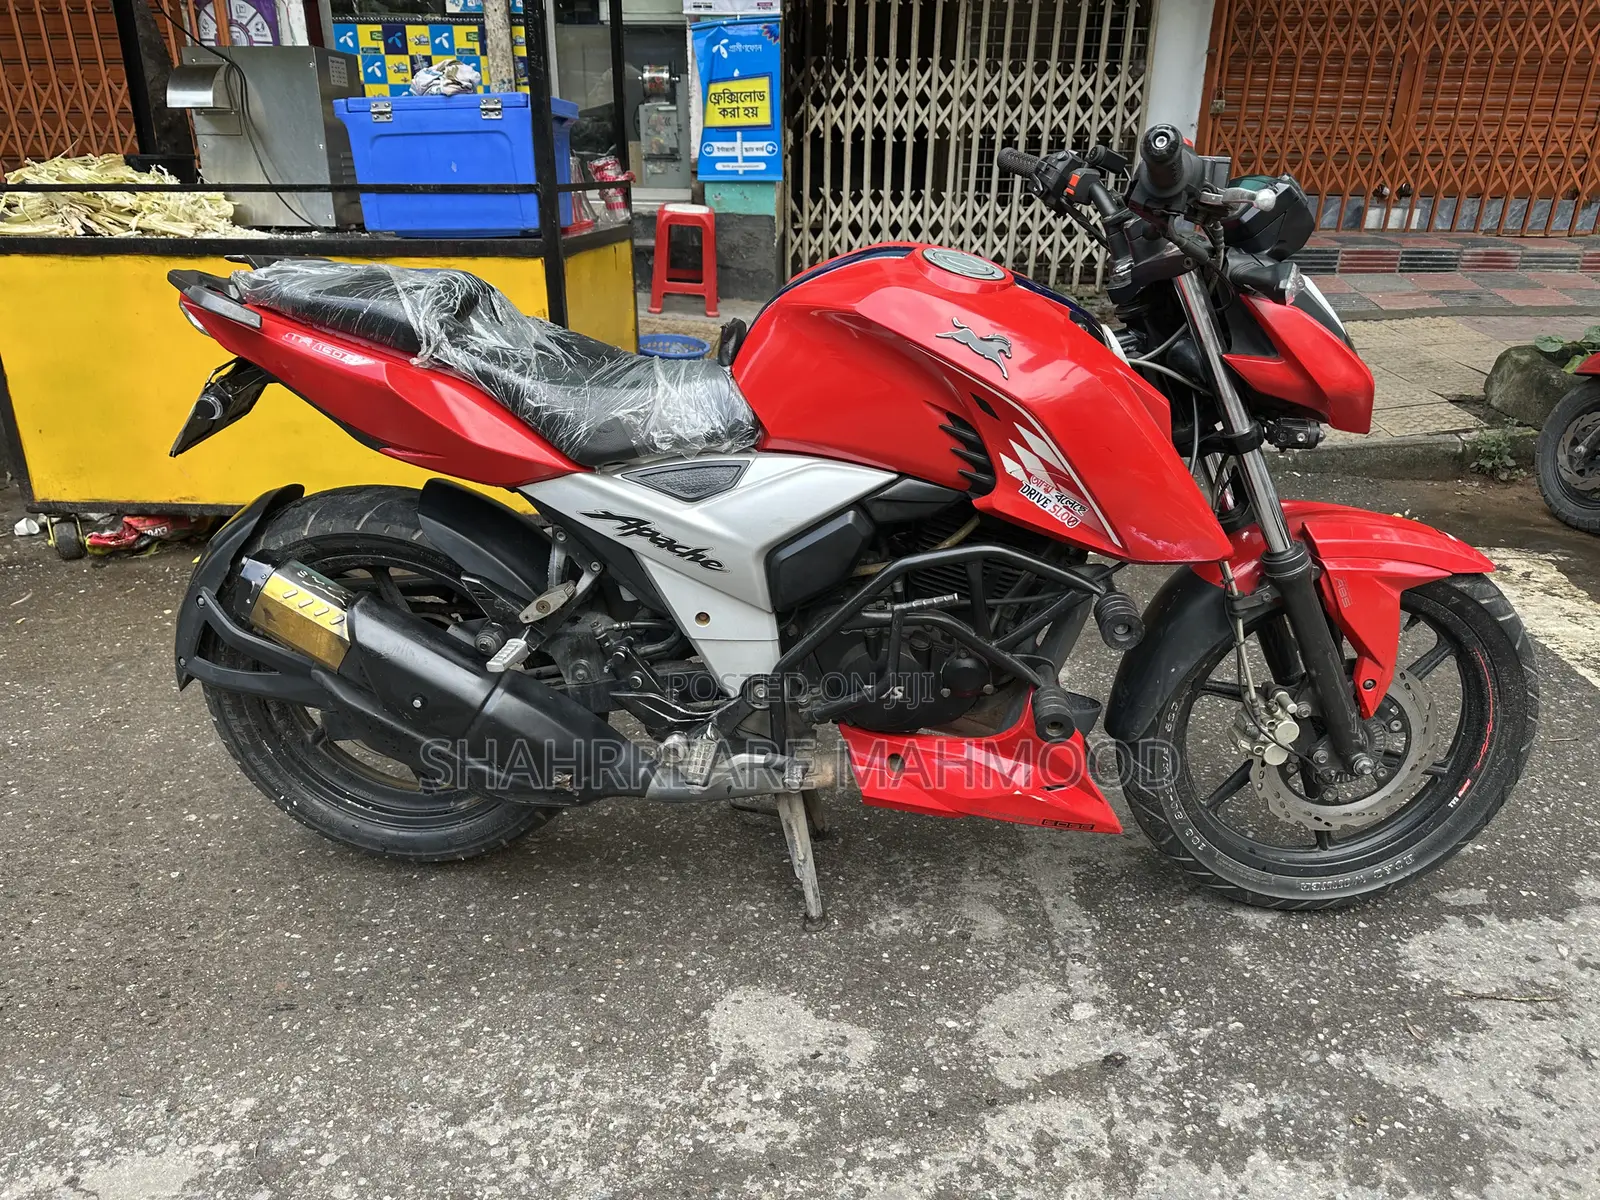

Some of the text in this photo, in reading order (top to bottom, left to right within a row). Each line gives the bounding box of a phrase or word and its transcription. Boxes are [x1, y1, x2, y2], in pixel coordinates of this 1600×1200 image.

[718, 106, 759, 118] করা হয়
[1020, 484, 1052, 509] DRIVE
[577, 510, 732, 573] Apache
[1447, 796, 1459, 808] TVS
